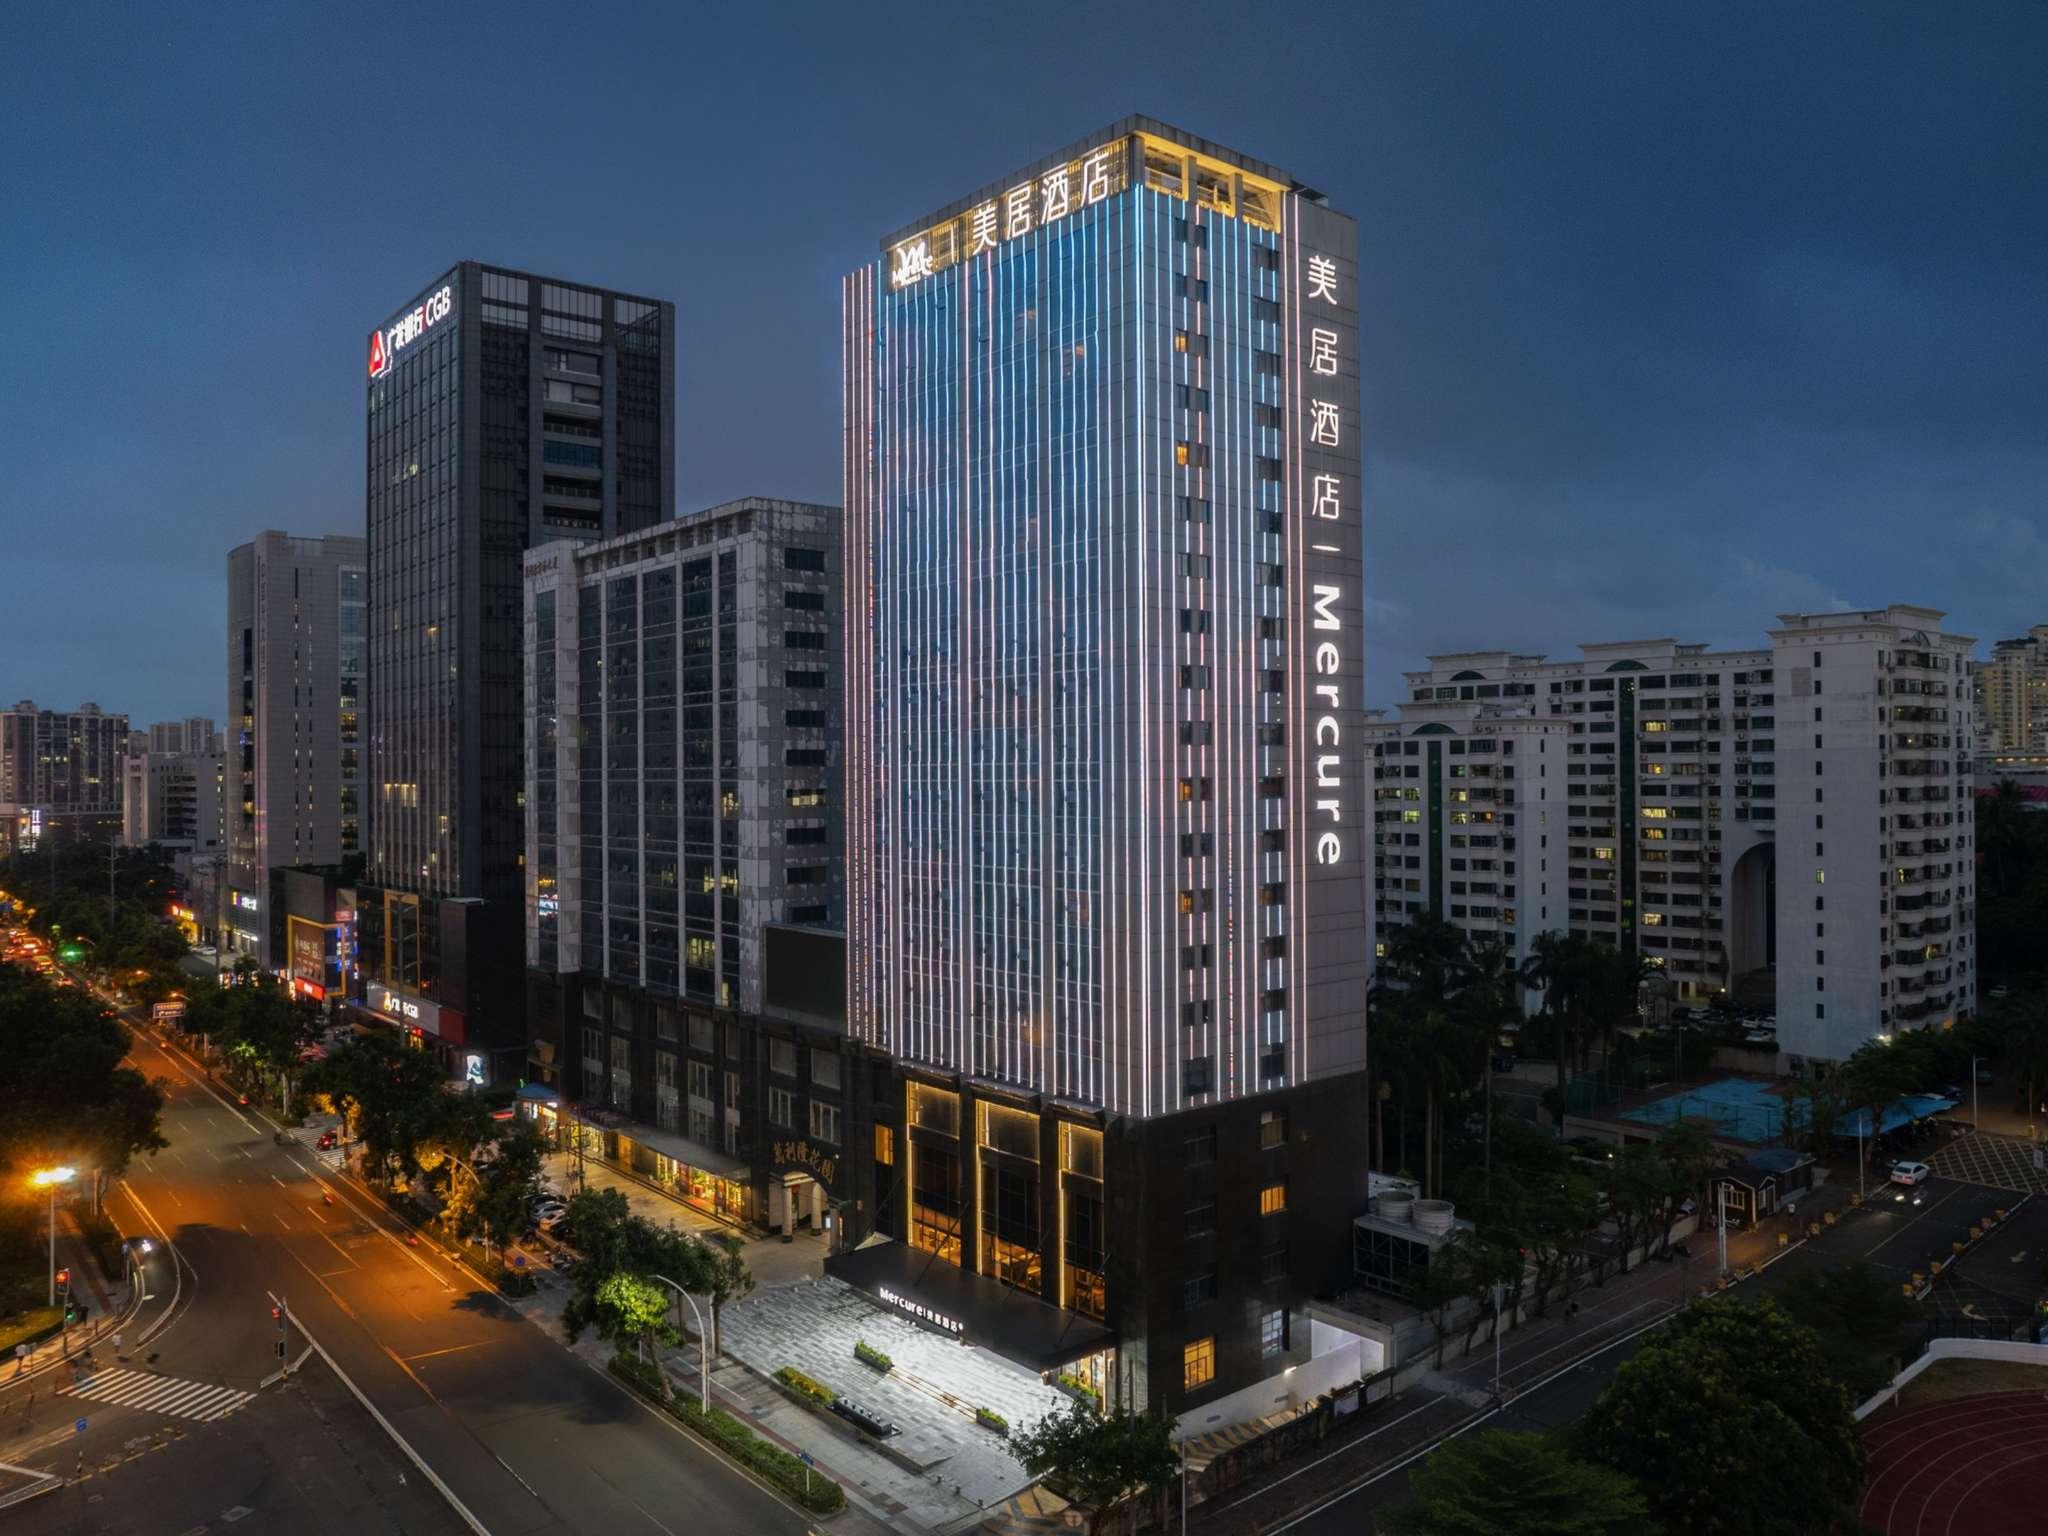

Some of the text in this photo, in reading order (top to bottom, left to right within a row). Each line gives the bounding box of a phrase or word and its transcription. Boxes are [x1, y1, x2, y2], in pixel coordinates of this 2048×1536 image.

[973, 151, 1109, 255] 美居酒店
[425, 286, 451, 327] CGB
[1307, 254, 1341, 519] 美居酒店
[1312, 584, 1341, 865] Mercure
[879, 1287, 923, 1316] Mercure
